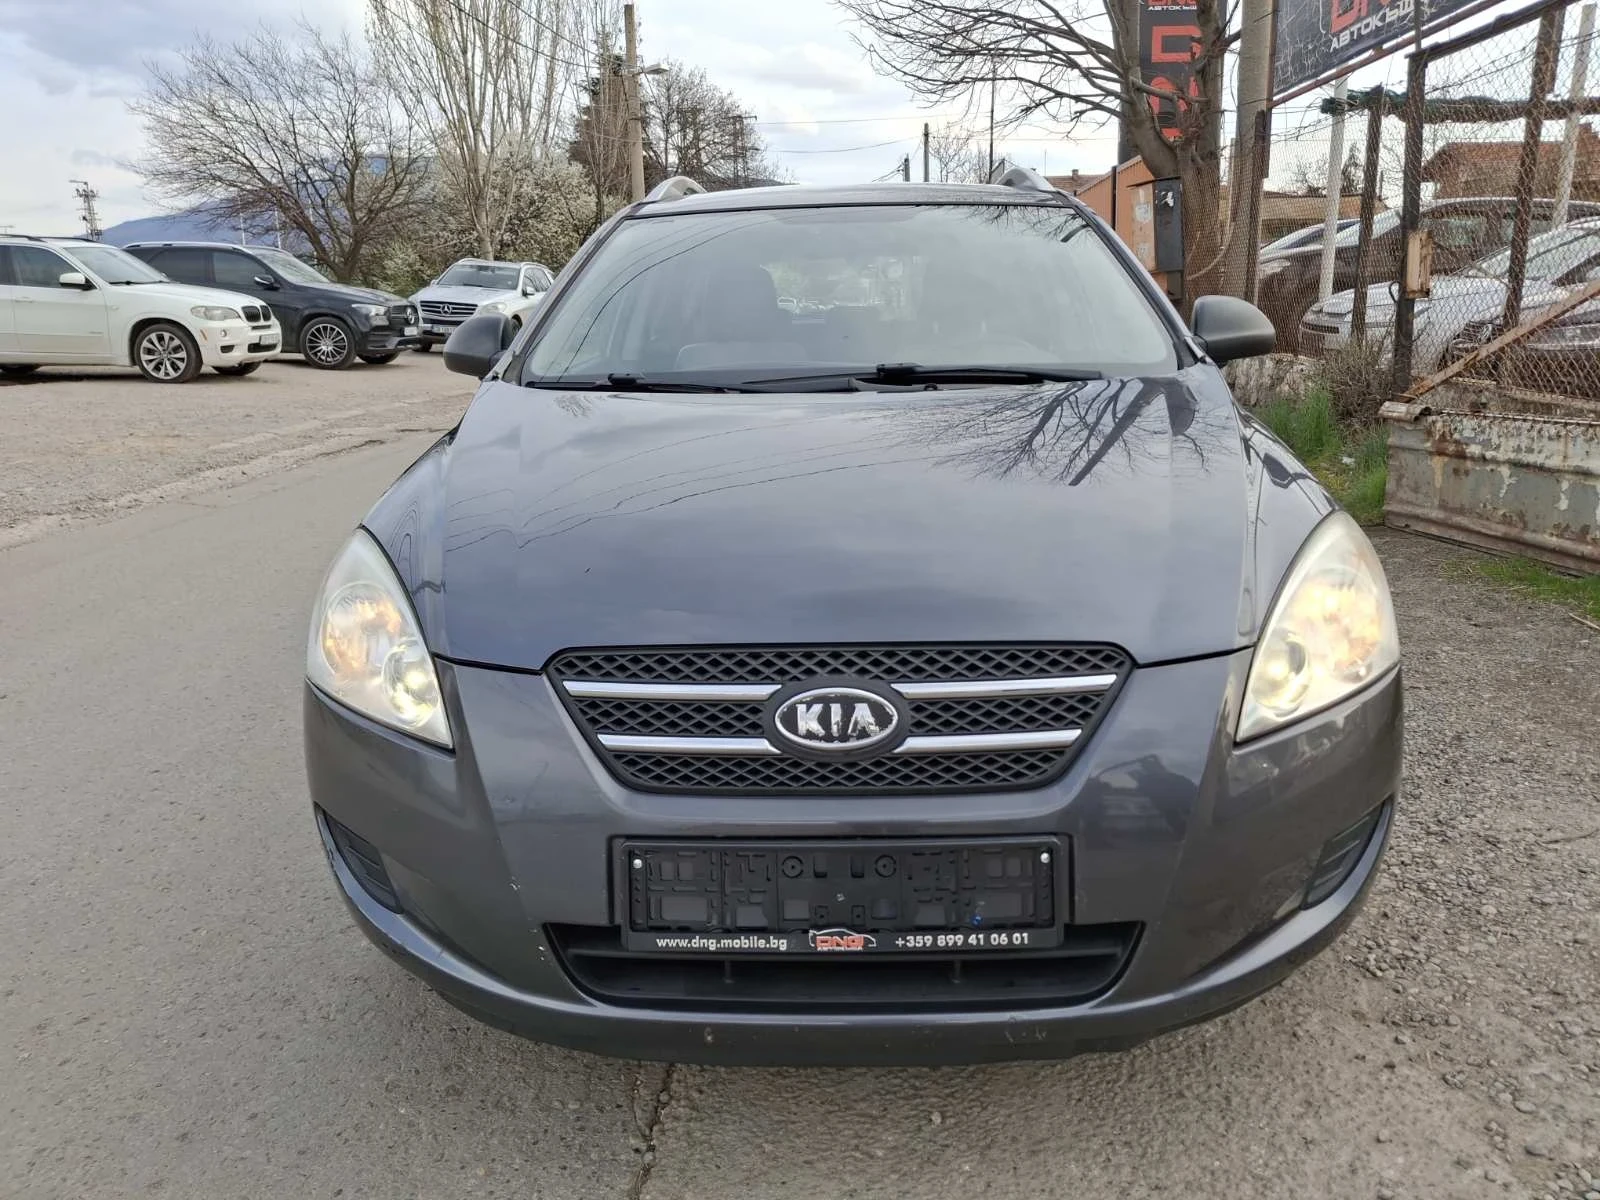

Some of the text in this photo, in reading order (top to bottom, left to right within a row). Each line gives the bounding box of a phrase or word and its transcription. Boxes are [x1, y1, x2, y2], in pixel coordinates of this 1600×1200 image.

[796, 703, 880, 737] KIA
[656, 936, 787, 950] www.dng.mobile.bg
[895, 932, 1029, 947] +359 899 41 06 01
